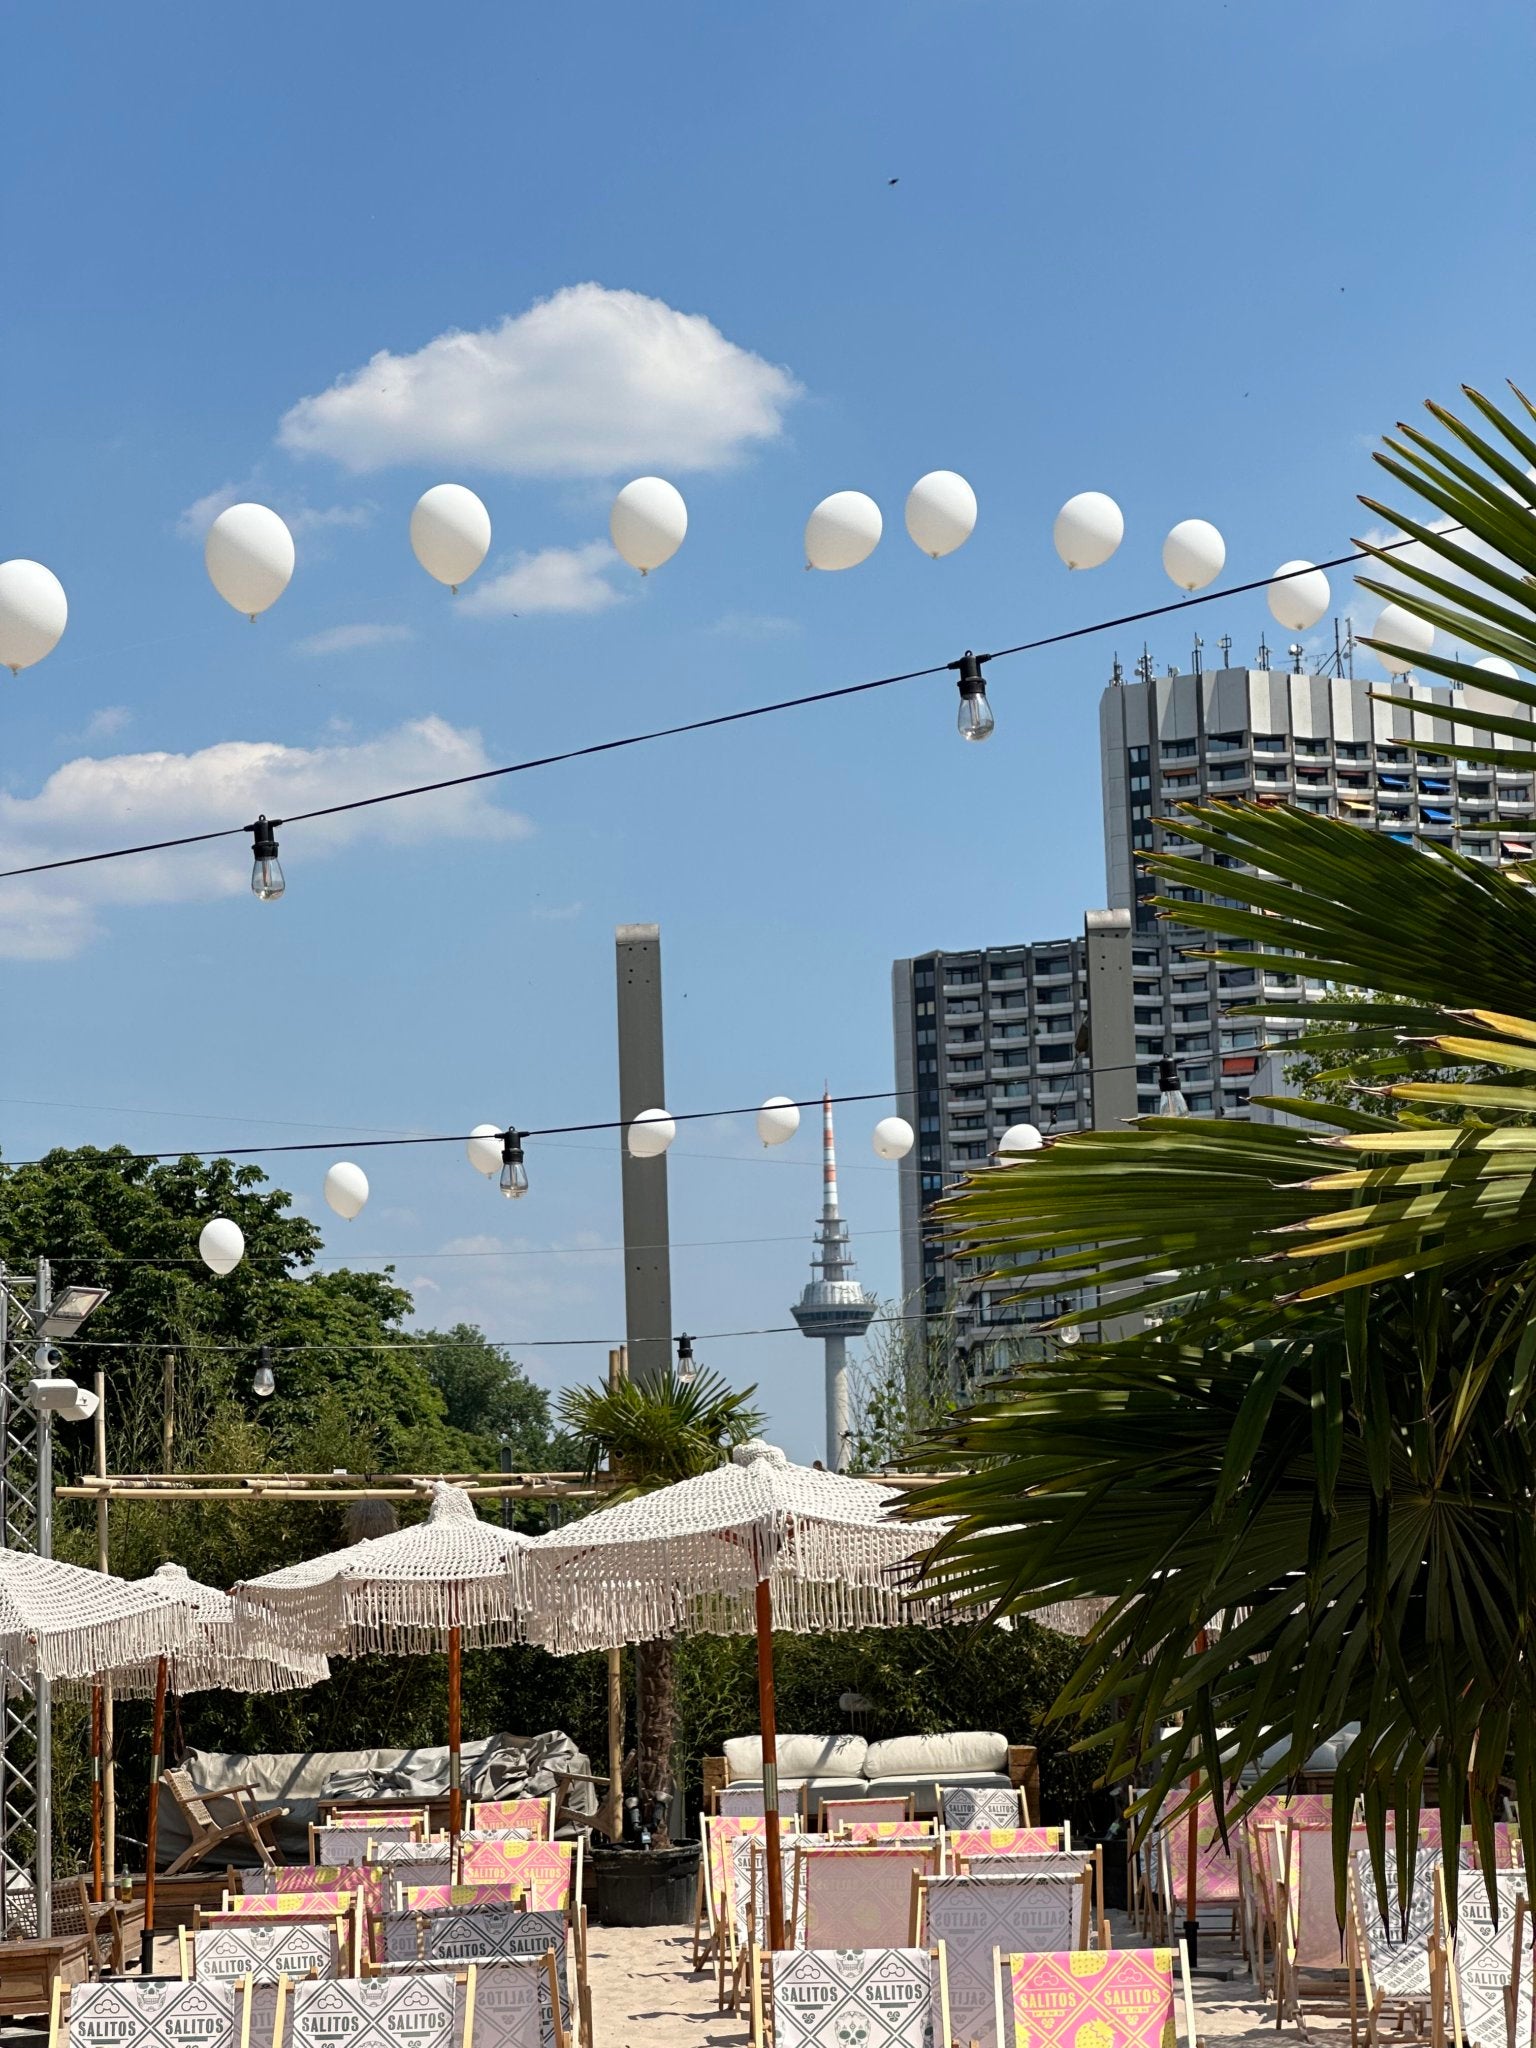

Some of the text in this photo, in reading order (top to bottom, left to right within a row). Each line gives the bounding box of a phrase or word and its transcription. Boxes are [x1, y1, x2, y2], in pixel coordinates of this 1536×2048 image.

[949, 1804, 975, 1812] SALITOS
[988, 1805, 1014, 1813] SALITOS
[468, 1867, 506, 1879] SALITOS
[523, 1867, 562, 1879] SALITOS
[1462, 1905, 1510, 1919] SALIS
[1373, 1929, 1413, 1940] SAITS
[438, 1943, 487, 1959] SALITOS
[509, 1937, 558, 1953] SALITOS
[203, 1959, 252, 1974] SALITOS
[275, 1955, 324, 1971] SALITOS
[782, 1986, 838, 2003] SALITOS
[866, 1984, 923, 2001] SALITOS
[1019, 1992, 1077, 2008] SALITOS
[1104, 1989, 1161, 2006] SALITOS
[78, 2021, 136, 2037] SALITOS
[165, 2018, 224, 2035] SALITOS
[302, 2016, 359, 2032] SALITOS
[388, 2012, 446, 2031] SALITOS
